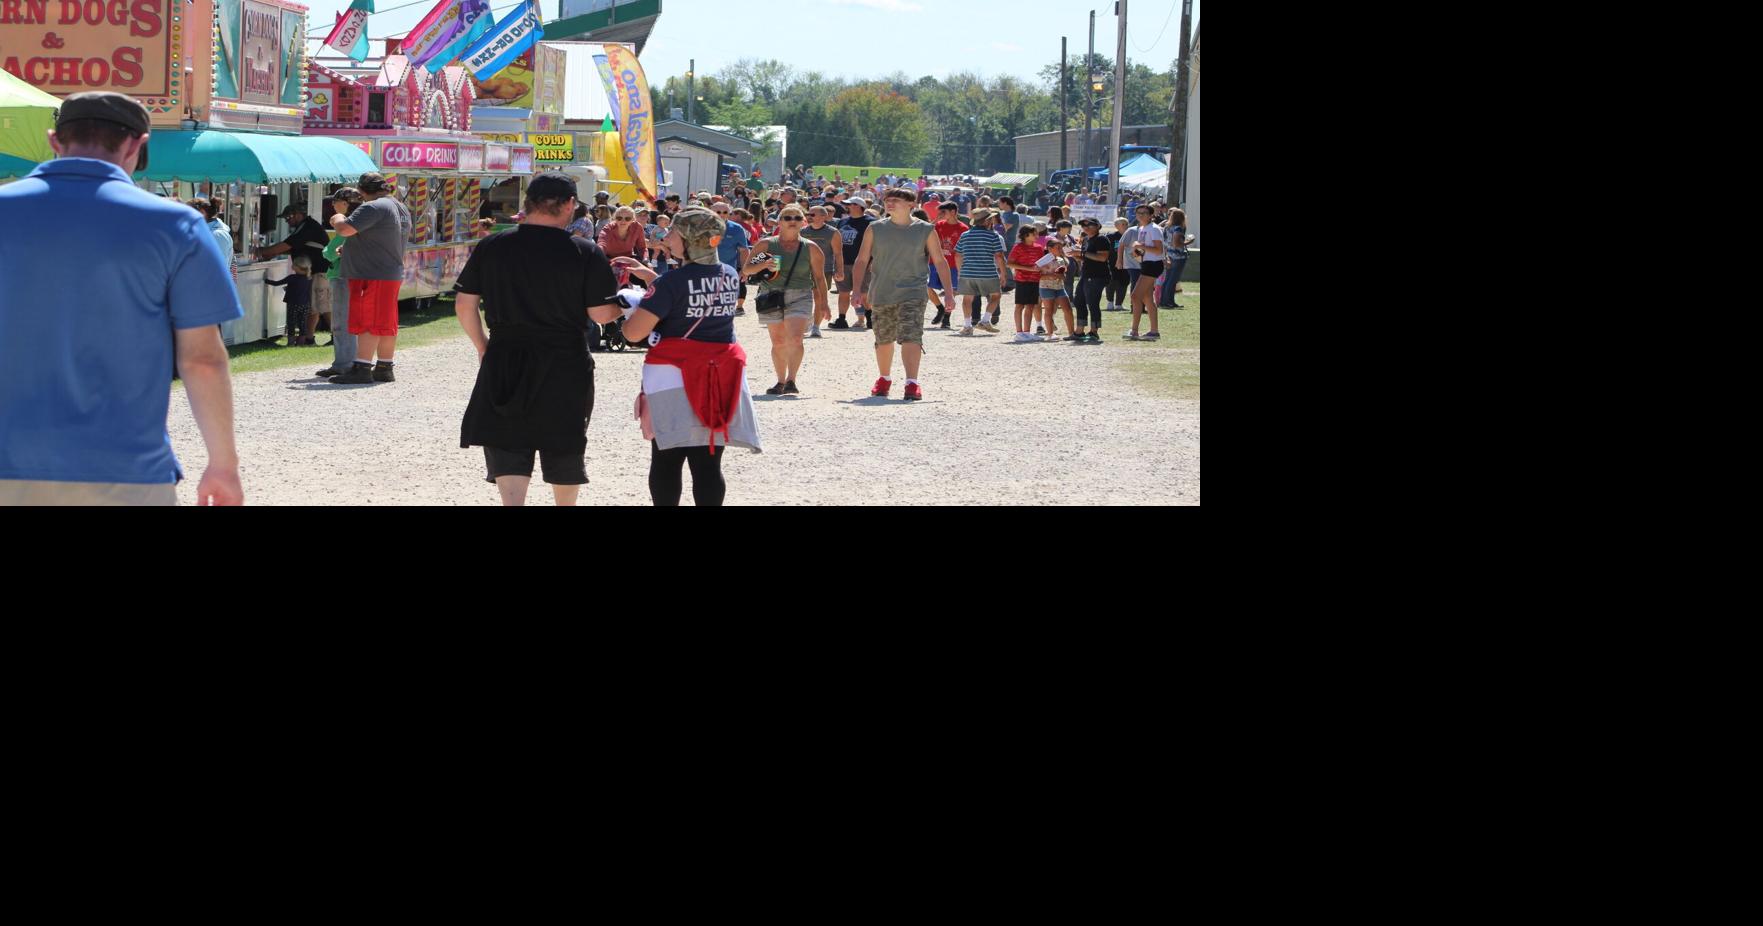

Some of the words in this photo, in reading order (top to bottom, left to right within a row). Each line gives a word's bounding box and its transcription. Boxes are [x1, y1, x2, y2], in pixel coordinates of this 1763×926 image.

[58, 0, 163, 38] DOGS
[41, 31, 65, 49] &
[535, 134, 565, 146] COLD
[386, 146, 422, 162] COLD
[426, 147, 457, 165] DRINKS
[688, 275, 739, 294] LIVING
[685, 307, 704, 317] 50
